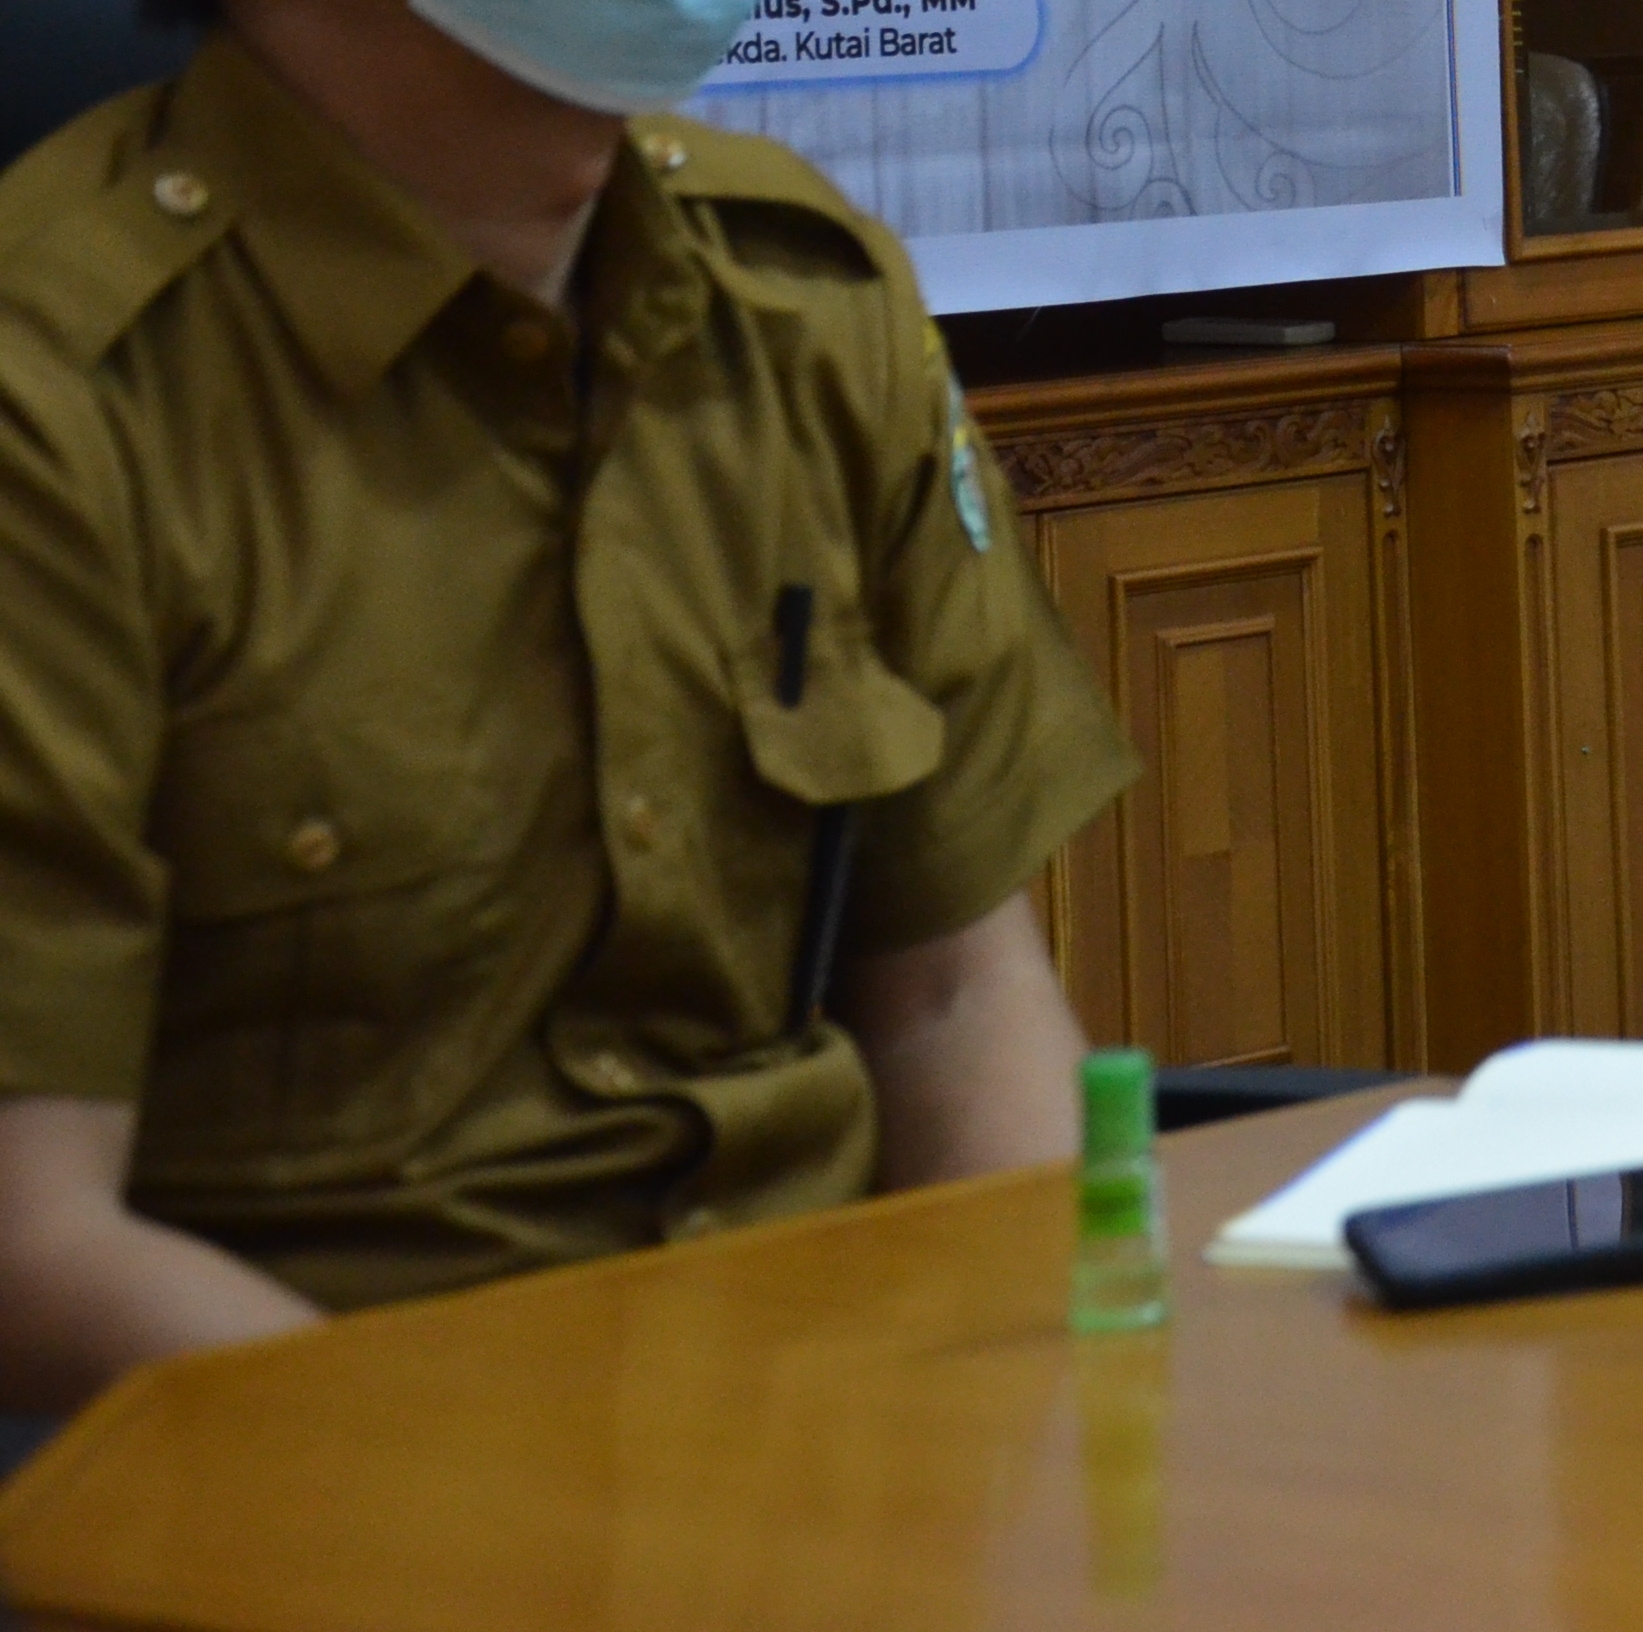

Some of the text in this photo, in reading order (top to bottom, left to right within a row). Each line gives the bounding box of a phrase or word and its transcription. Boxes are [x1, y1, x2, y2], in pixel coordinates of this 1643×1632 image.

[718, 26, 958, 65] kda. Kutai Barat
